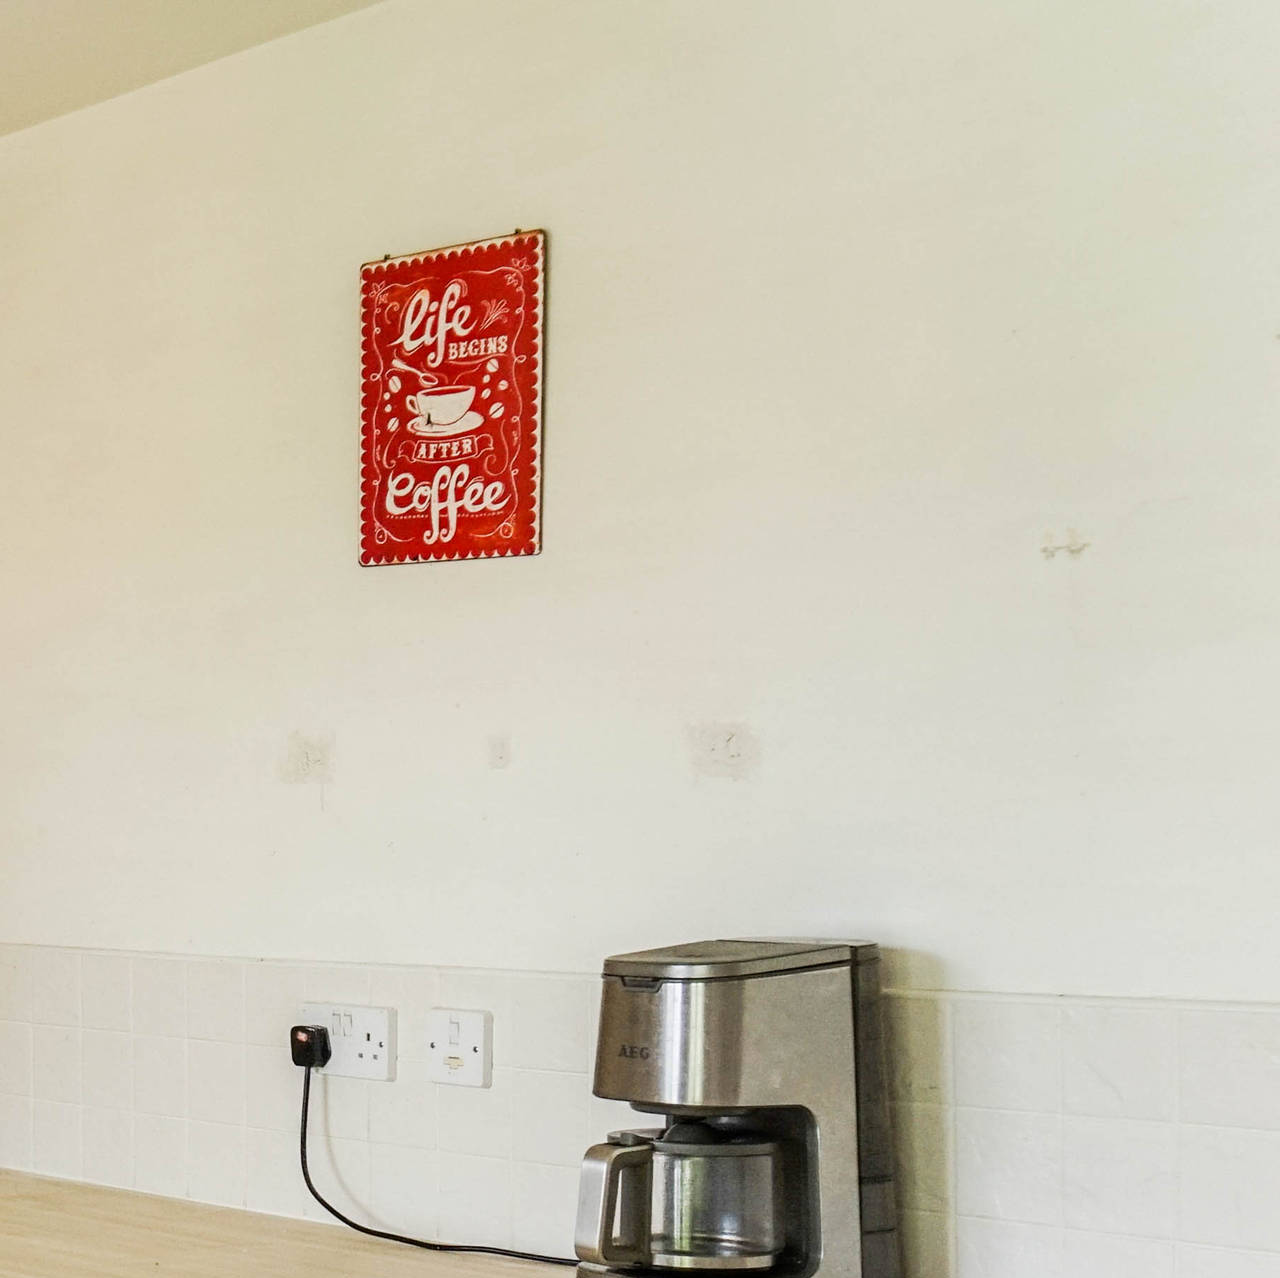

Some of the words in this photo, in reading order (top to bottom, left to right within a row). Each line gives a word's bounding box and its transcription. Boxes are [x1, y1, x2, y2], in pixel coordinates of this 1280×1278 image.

[386, 283, 477, 367] life
[448, 335, 508, 360] BEGINS
[417, 438, 473, 459] AFTER
[385, 463, 511, 545] Coffee
[618, 1044, 650, 1060] AEG
